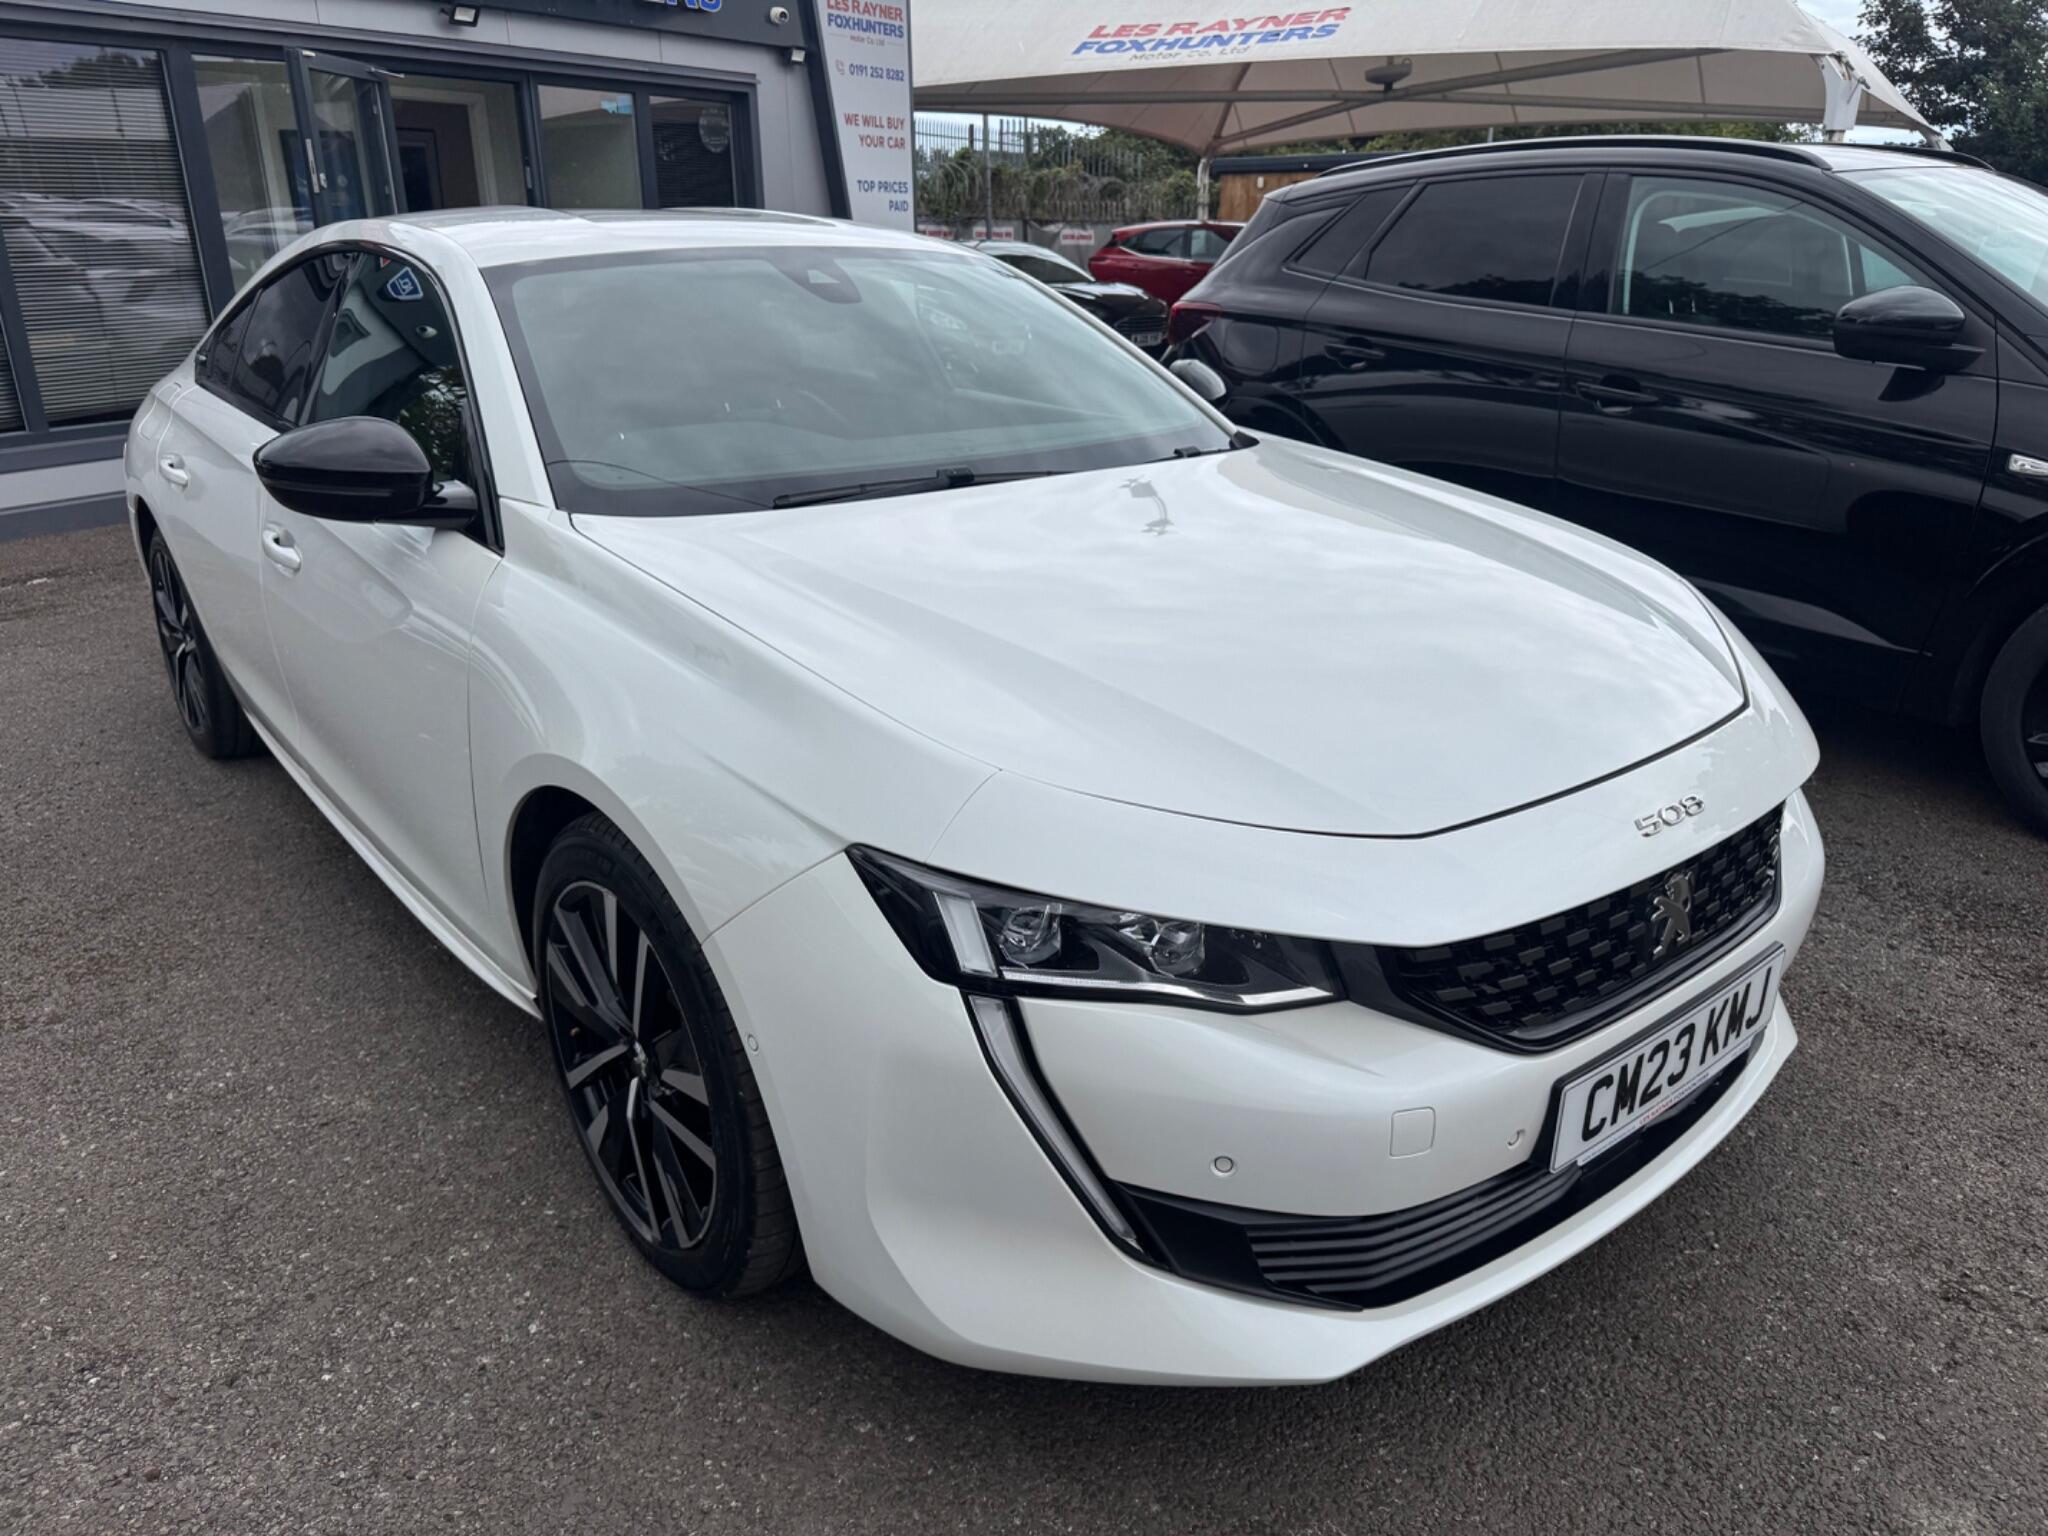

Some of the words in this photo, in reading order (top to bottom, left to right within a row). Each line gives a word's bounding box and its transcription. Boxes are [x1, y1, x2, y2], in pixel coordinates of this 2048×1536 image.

[827, 0, 849, 12] LES
[852, 0, 903, 22] RAYNER
[827, 13, 904, 39] FOXHUNTERS
[1088, 23, 1162, 39] LES
[1166, 7, 1351, 36] RAYNER
[1072, 24, 1340, 55] FOXHUNTERS
[1129, 51, 1181, 61] Motor
[849, 63, 868, 77] 0191
[870, 66, 884, 79] 252
[886, 68, 905, 82] 8282
[844, 113, 860, 127] WE
[862, 115, 885, 129] WILL
[887, 117, 906, 130] BUY
[859, 134, 885, 148] YOUR
[887, 136, 906, 150] CAR
[857, 180, 875, 193] TOP
[878, 181, 909, 194] PRICES
[889, 200, 909, 212] PAID
[1634, 793, 1705, 838] 508
[1581, 1022, 1697, 1143] CM23
[1699, 966, 1773, 1066] KMJ
